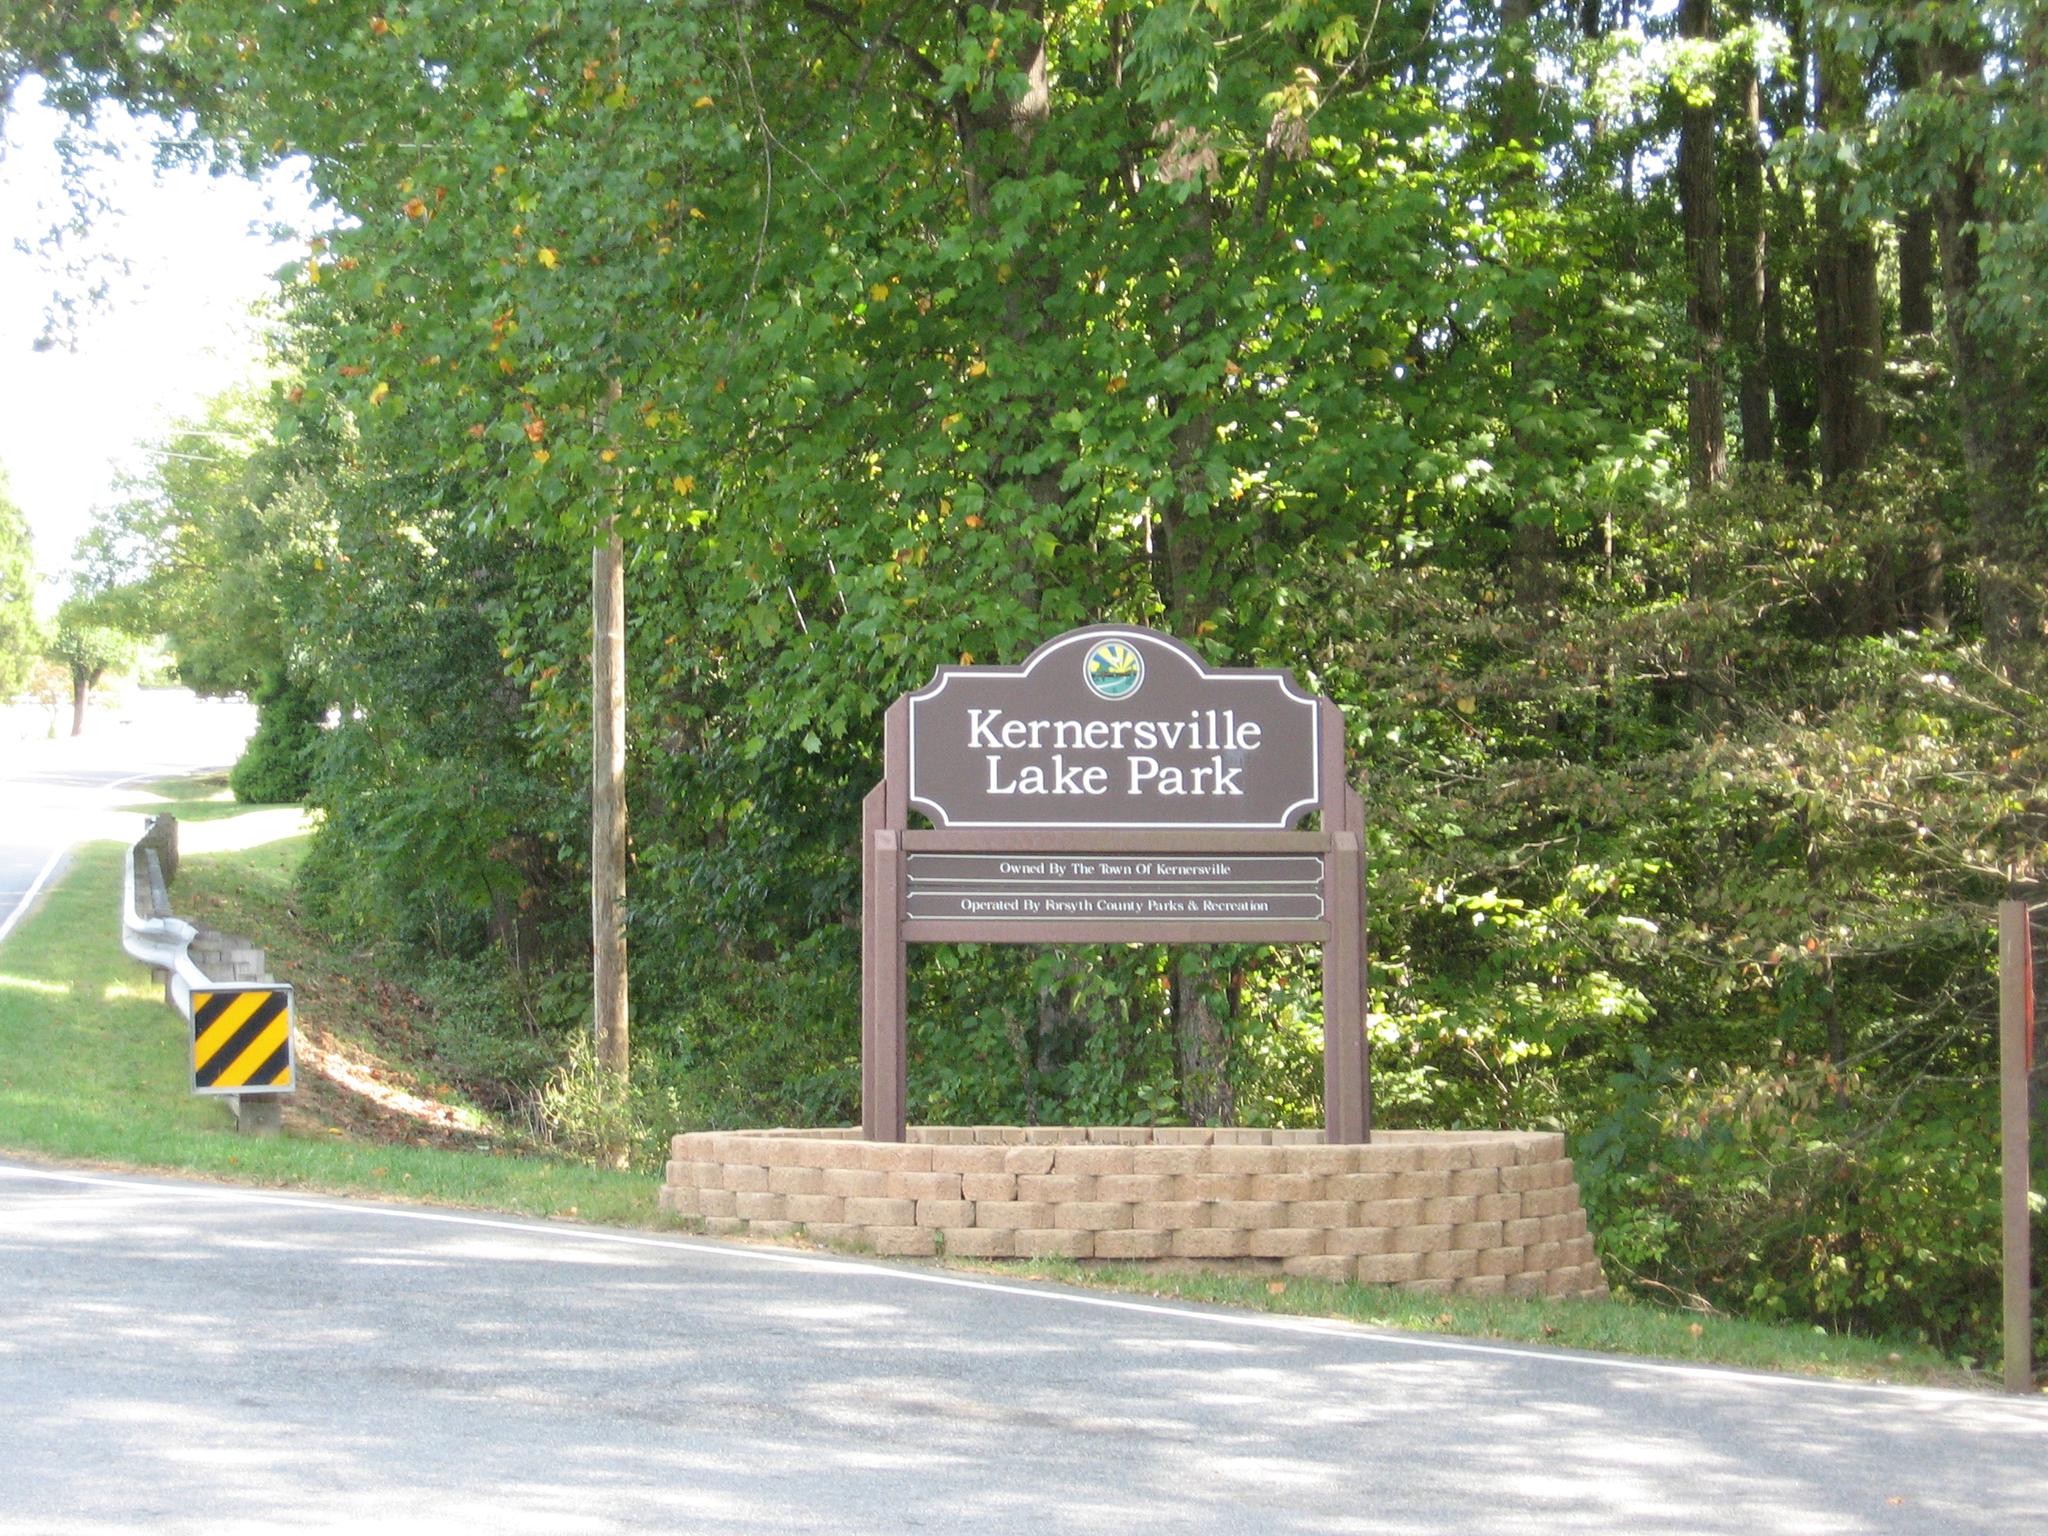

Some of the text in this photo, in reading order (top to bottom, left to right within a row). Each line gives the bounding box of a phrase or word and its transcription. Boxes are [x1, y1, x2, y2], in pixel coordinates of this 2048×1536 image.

[967, 709, 1261, 750] Kernersville
[986, 754, 1244, 796] Lake Park
[999, 862, 1232, 878] Owned By The Town Of Kernersville
[960, 897, 1270, 914] Operated By Forsyth County Parks & Recreation
